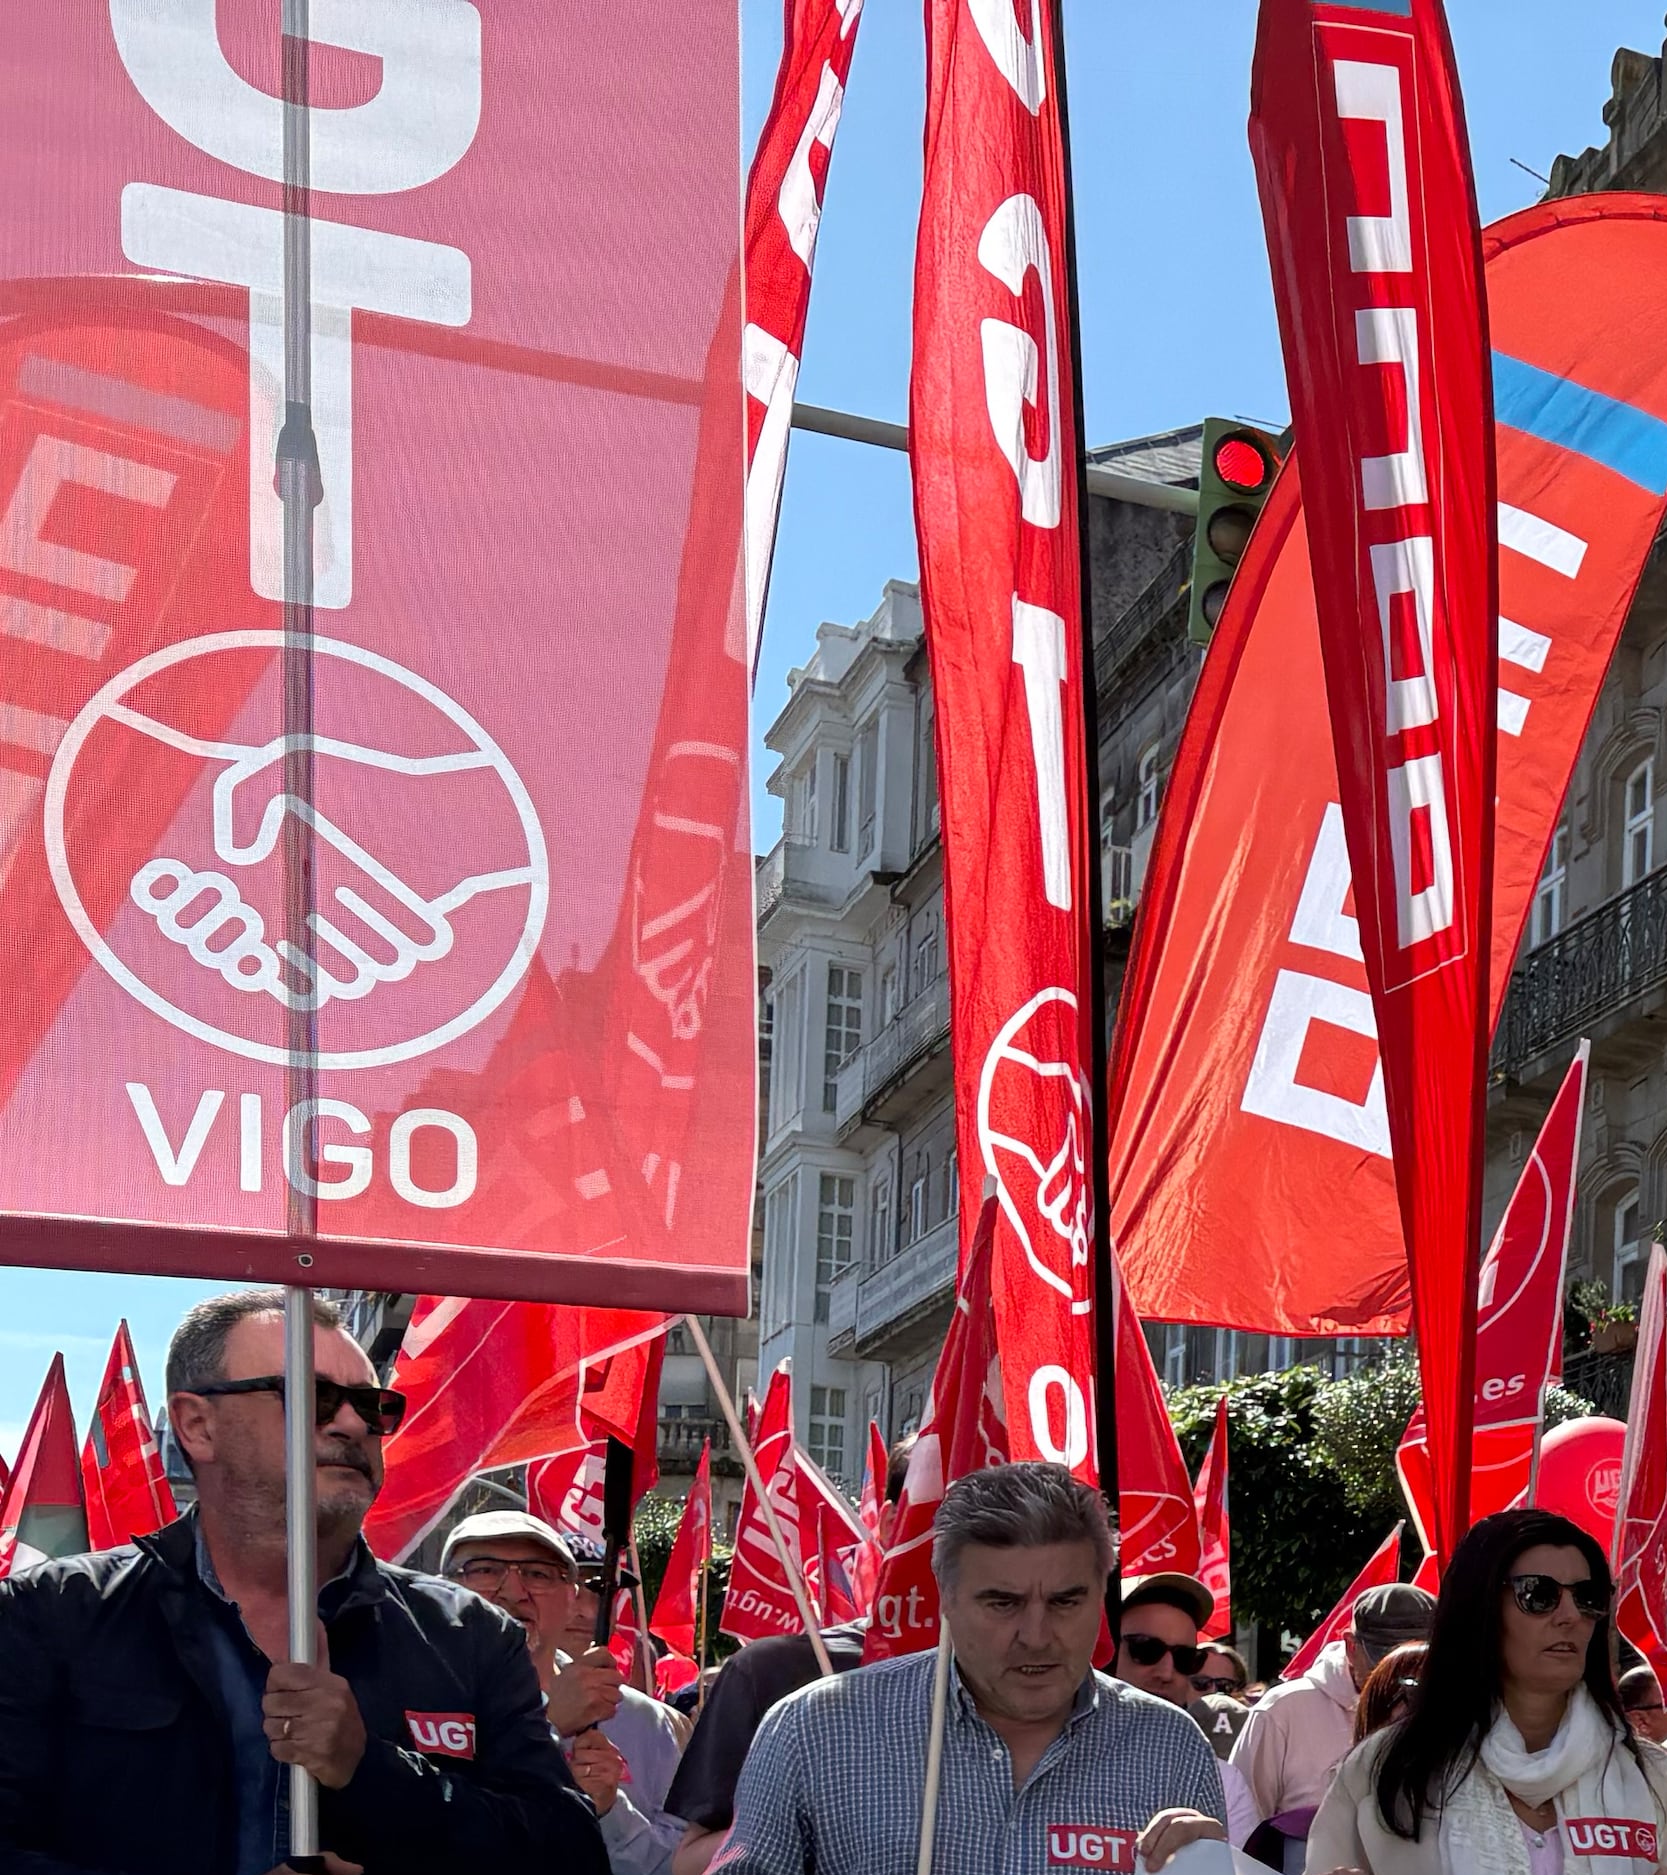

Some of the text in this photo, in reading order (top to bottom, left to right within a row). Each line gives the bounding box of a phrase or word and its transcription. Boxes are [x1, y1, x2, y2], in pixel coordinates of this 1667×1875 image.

[125, 1082, 479, 1210] VIGO
[1213, 1711, 1234, 1735] A
[1051, 1831, 1127, 1864] UGT
[1571, 1824, 1632, 1852] UGT
